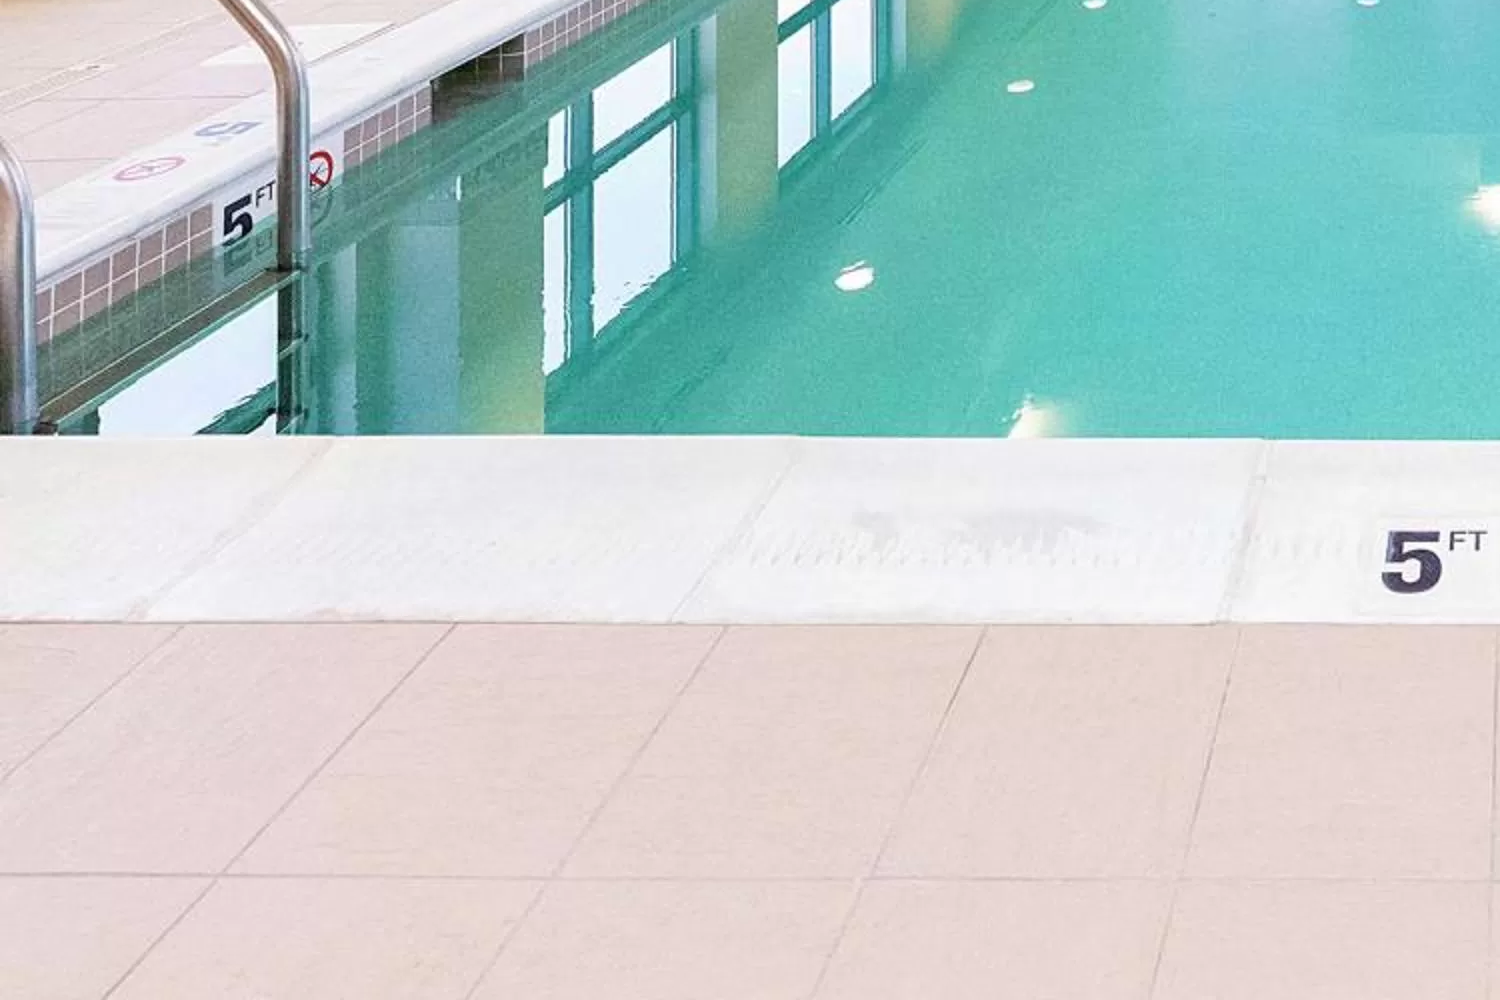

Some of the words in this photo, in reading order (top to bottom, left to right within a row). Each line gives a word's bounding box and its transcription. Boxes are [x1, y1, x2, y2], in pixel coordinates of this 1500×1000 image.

[222, 193, 253, 246] 5
[255, 178, 276, 208] FT
[1381, 530, 1443, 594] 5
[1449, 530, 1488, 551] FT
